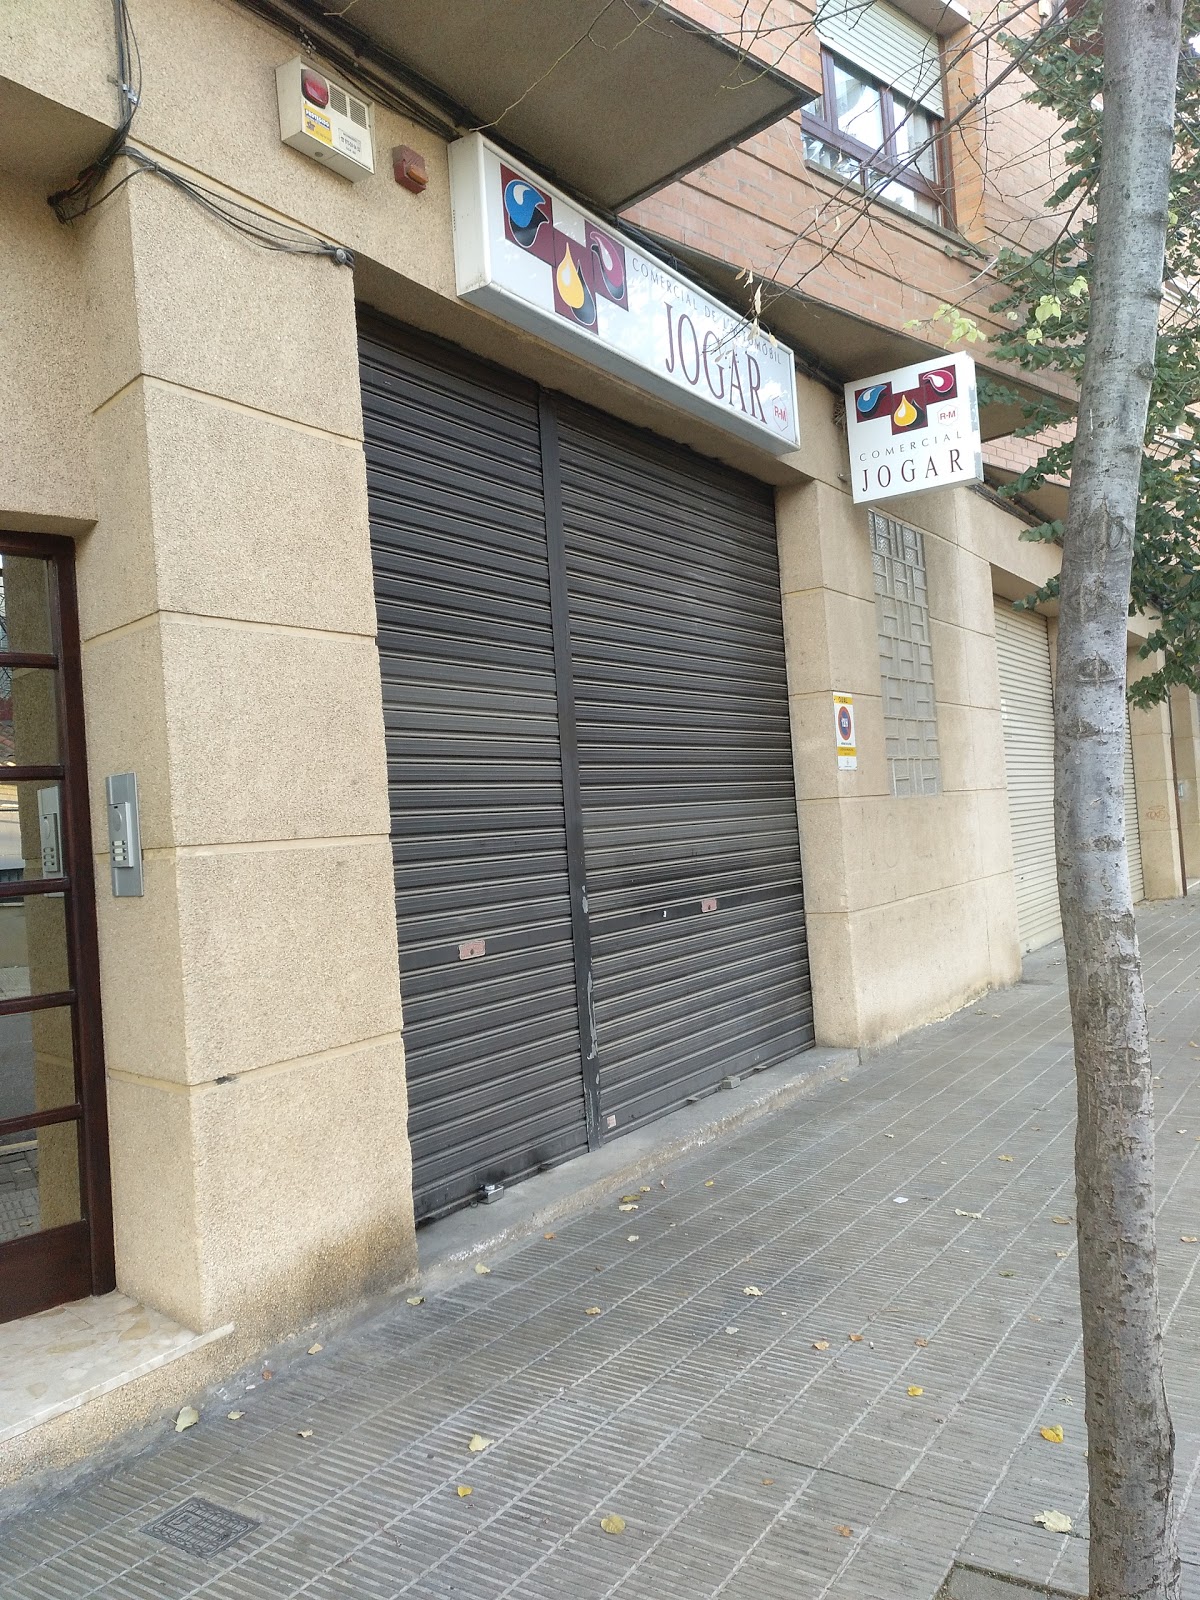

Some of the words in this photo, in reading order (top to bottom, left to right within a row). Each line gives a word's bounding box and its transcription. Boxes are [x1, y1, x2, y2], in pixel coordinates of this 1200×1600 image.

[632, 257, 698, 311] COMERCIAL
[704, 305, 717, 323] DE
[665, 302, 768, 425] JOGAR
[774, 405, 787, 422] R-M
[939, 409, 956, 421] R-M
[859, 430, 962, 462] COMERCIAL
[862, 448, 964, 492] JOGAR
